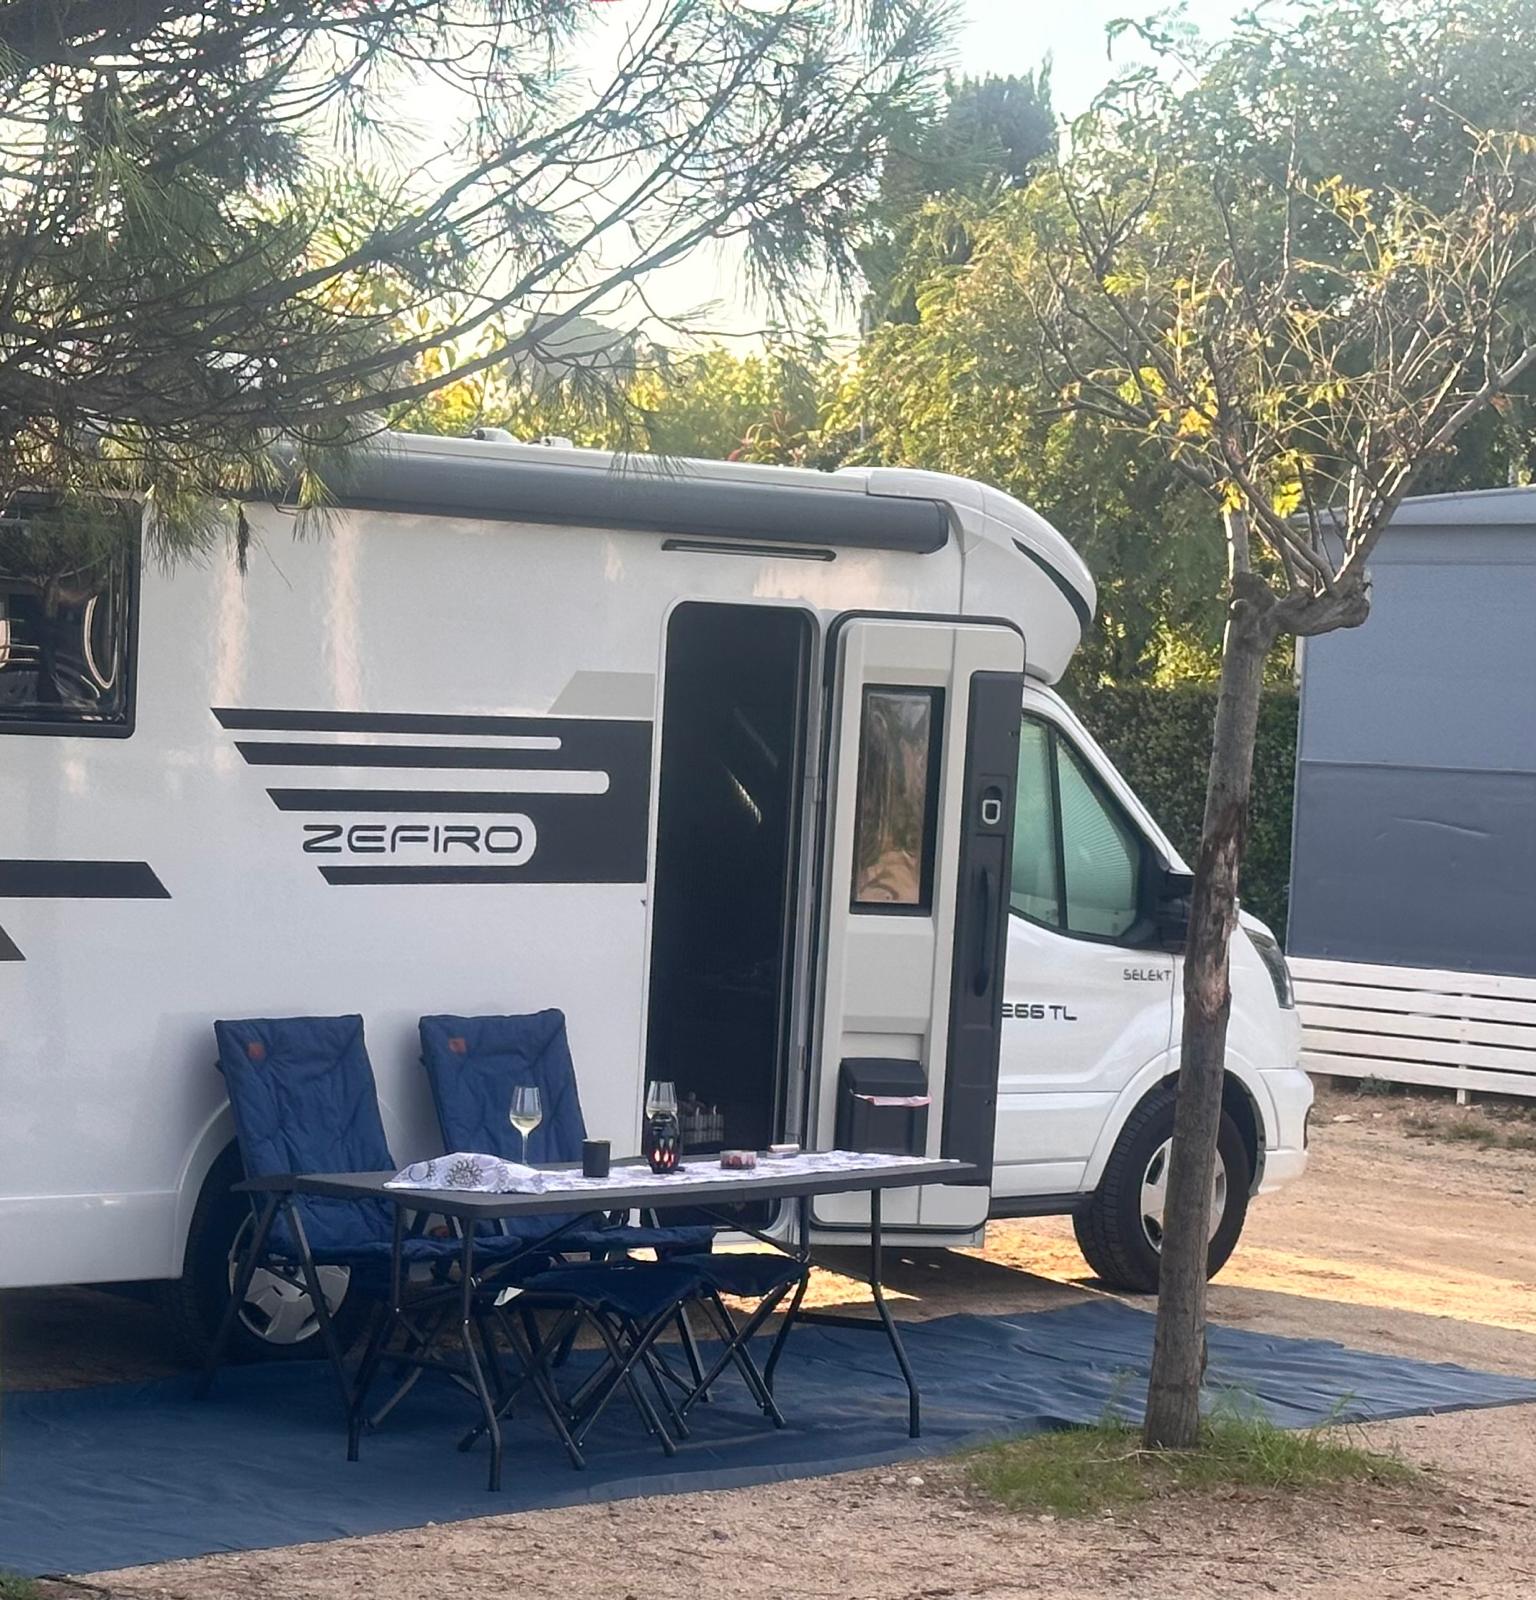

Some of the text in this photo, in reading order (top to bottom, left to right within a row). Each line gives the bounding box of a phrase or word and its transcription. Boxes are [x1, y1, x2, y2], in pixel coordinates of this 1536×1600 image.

[302, 824, 523, 854] ZEFIRO
[1123, 968, 1172, 981] SELEKT
[1048, 1005, 1078, 1021] TL
